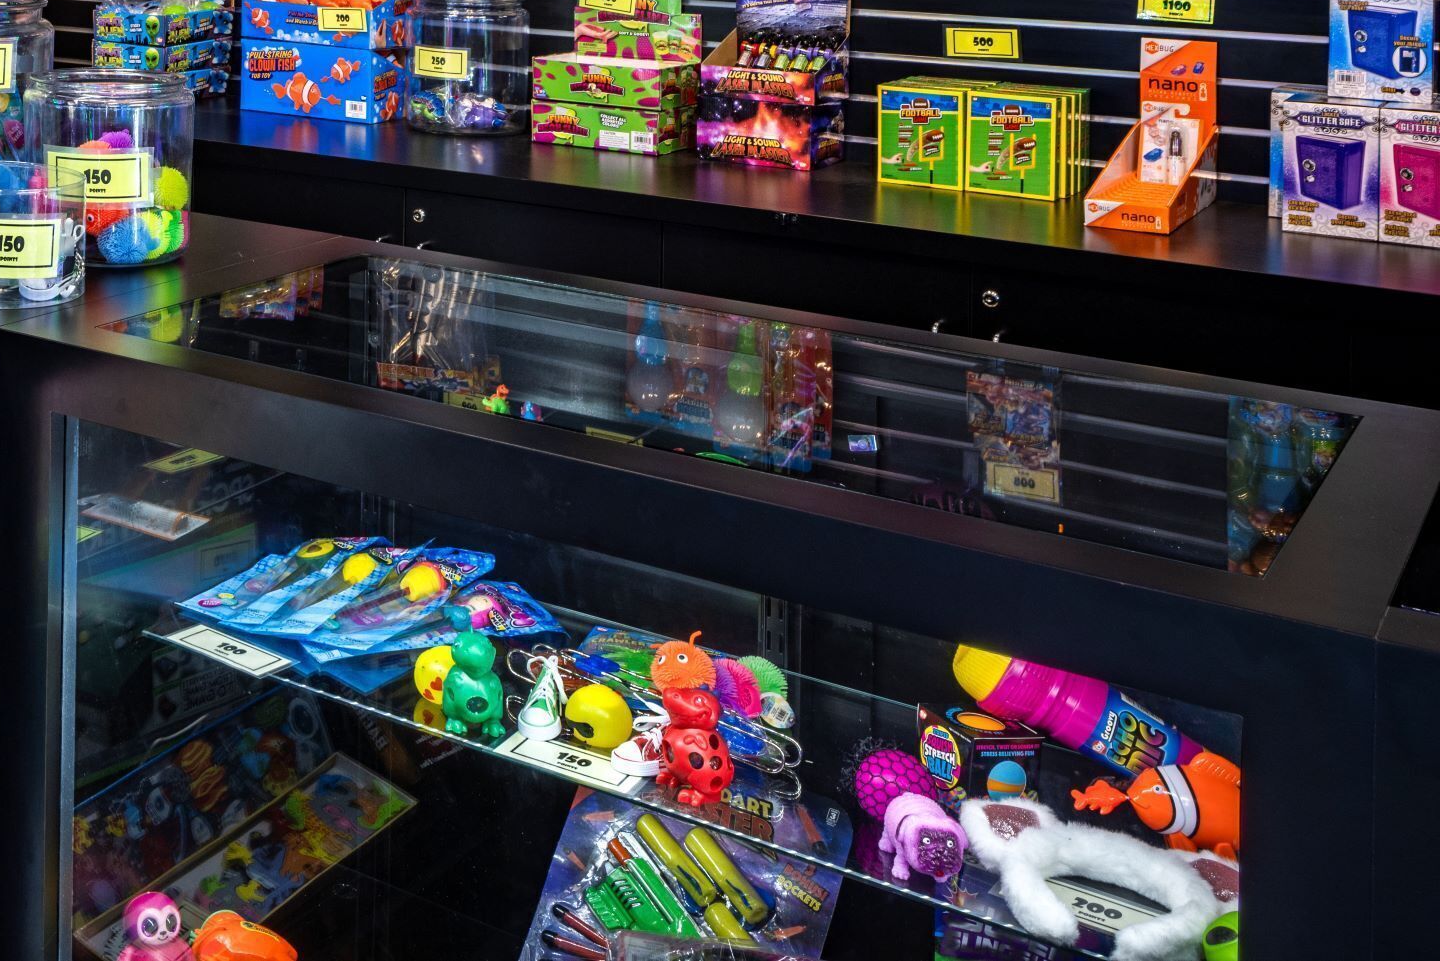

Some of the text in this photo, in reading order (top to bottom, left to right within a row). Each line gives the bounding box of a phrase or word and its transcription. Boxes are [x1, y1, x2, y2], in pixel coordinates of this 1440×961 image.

[1163, 0, 1191, 12] 1100
[973, 37, 994, 47] 500
[431, 56, 445, 65] 250
[1148, 75, 1198, 93] nano
[85, 169, 111, 184] 150
[1121, 213, 1156, 223] nano
[215, 642, 246, 656] 100
[556, 752, 592, 767] 150
[1071, 897, 1122, 920] 200
